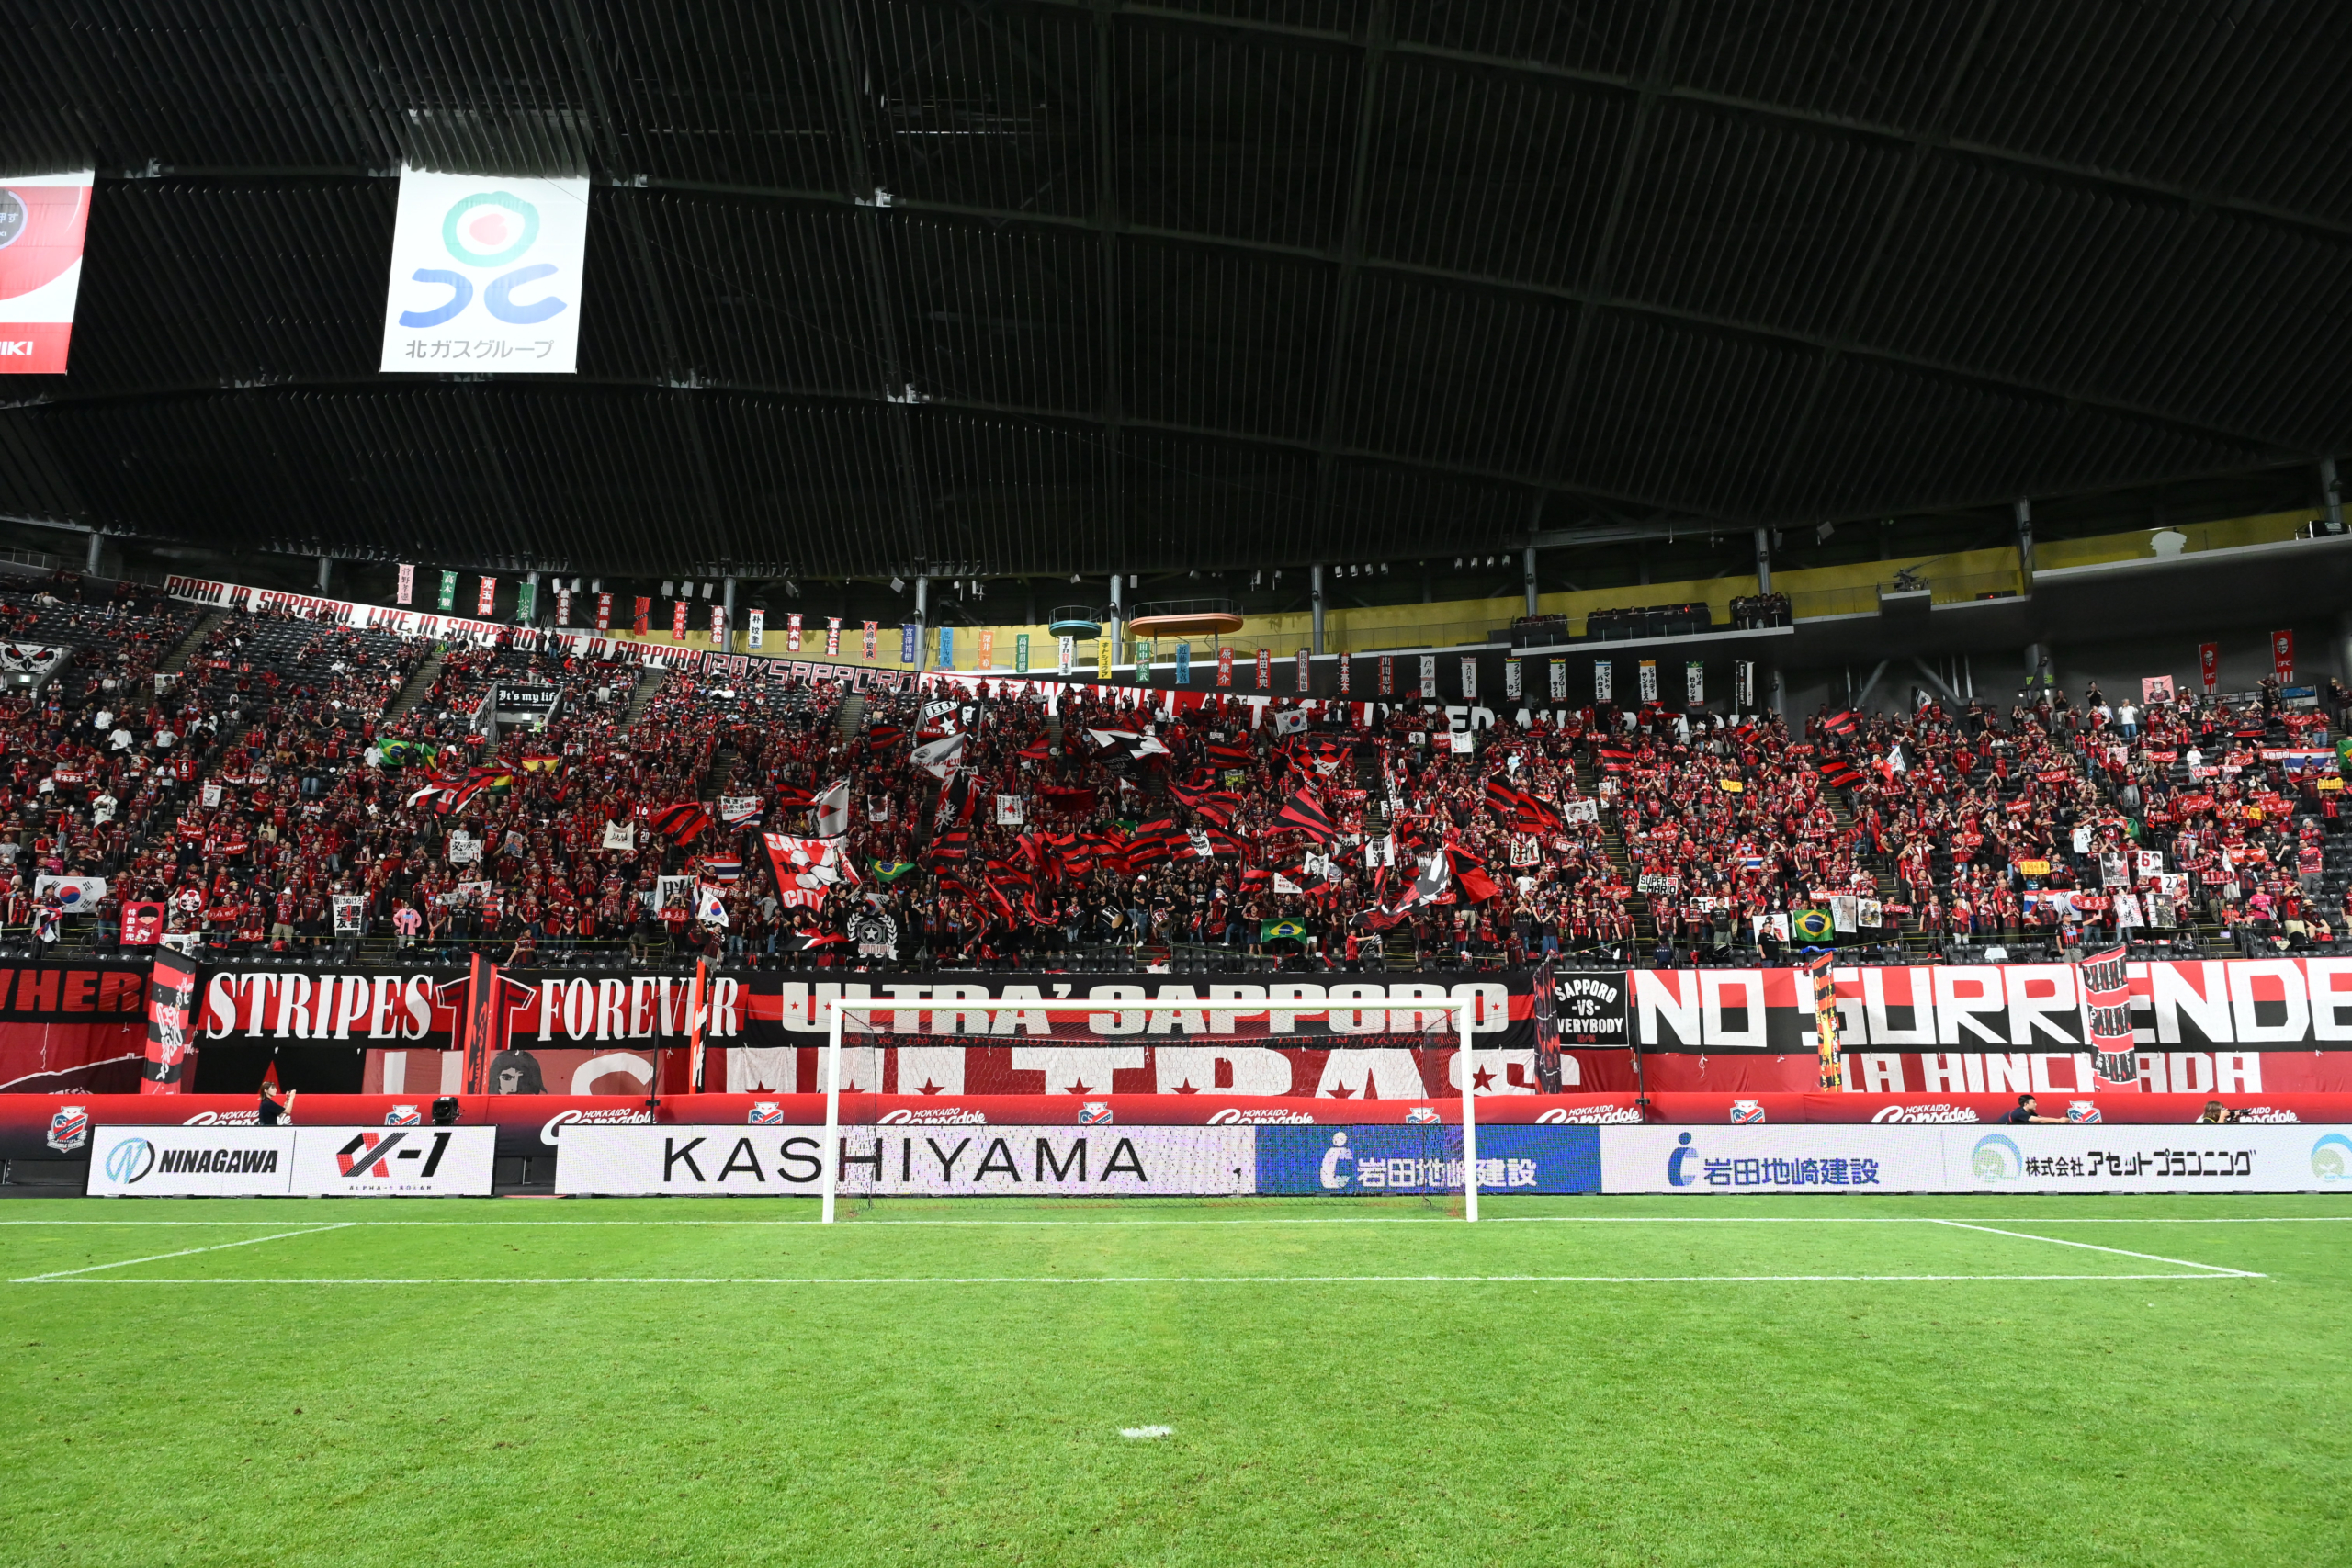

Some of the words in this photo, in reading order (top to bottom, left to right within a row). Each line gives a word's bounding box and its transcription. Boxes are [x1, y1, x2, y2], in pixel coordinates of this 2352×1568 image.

[0, 341, 33, 356] IKI
[406, 340, 554, 359] 北ガスグループ
[168, 576, 223, 603] BORN
[1220, 649, 1232, 686] 原康介
[1340, 656, 1350, 692] 青木亮太
[499, 689, 520, 701] It's
[522, 694, 539, 704] my
[541, 691, 557, 702] lif
[182, 762, 187, 771] 6
[641, 831, 650, 840] 20
[1372, 839, 1388, 864] 前進
[2141, 852, 2150, 867] 6
[1641, 874, 1668, 885] SUPER
[1646, 885, 1676, 895] MARIO
[334, 897, 363, 906] 駆けぬけろ
[127, 908, 136, 942] 林田友兜
[160, 936, 165, 944] 6
[1555, 978, 1618, 1004] SAPPORO
[206, 972, 434, 1041] STRIPES
[1088, 983, 1510, 1035] SAPPORO
[1634, 968, 1767, 1046] NO
[1556, 1017, 1624, 1035] VERYBODY
[1839, 1053, 1905, 1093] LA
[219, 1111, 261, 1120] HOKKAID
[583, 1108, 631, 1119] HOKKAIDO
[913, 1107, 960, 1117] HOKKAIDO
[1241, 1108, 1289, 1118] HOKKAIDO
[1568, 1105, 1614, 1115] HOKKAIDO
[1905, 1104, 1951, 1114] HOKKAIDO
[1734, 1112, 1747, 1122] CS
[2070, 1113, 2084, 1122] CS
[158, 1149, 278, 1174] NINAGAWA
[662, 1137, 1148, 1183] KASHIYAMA
